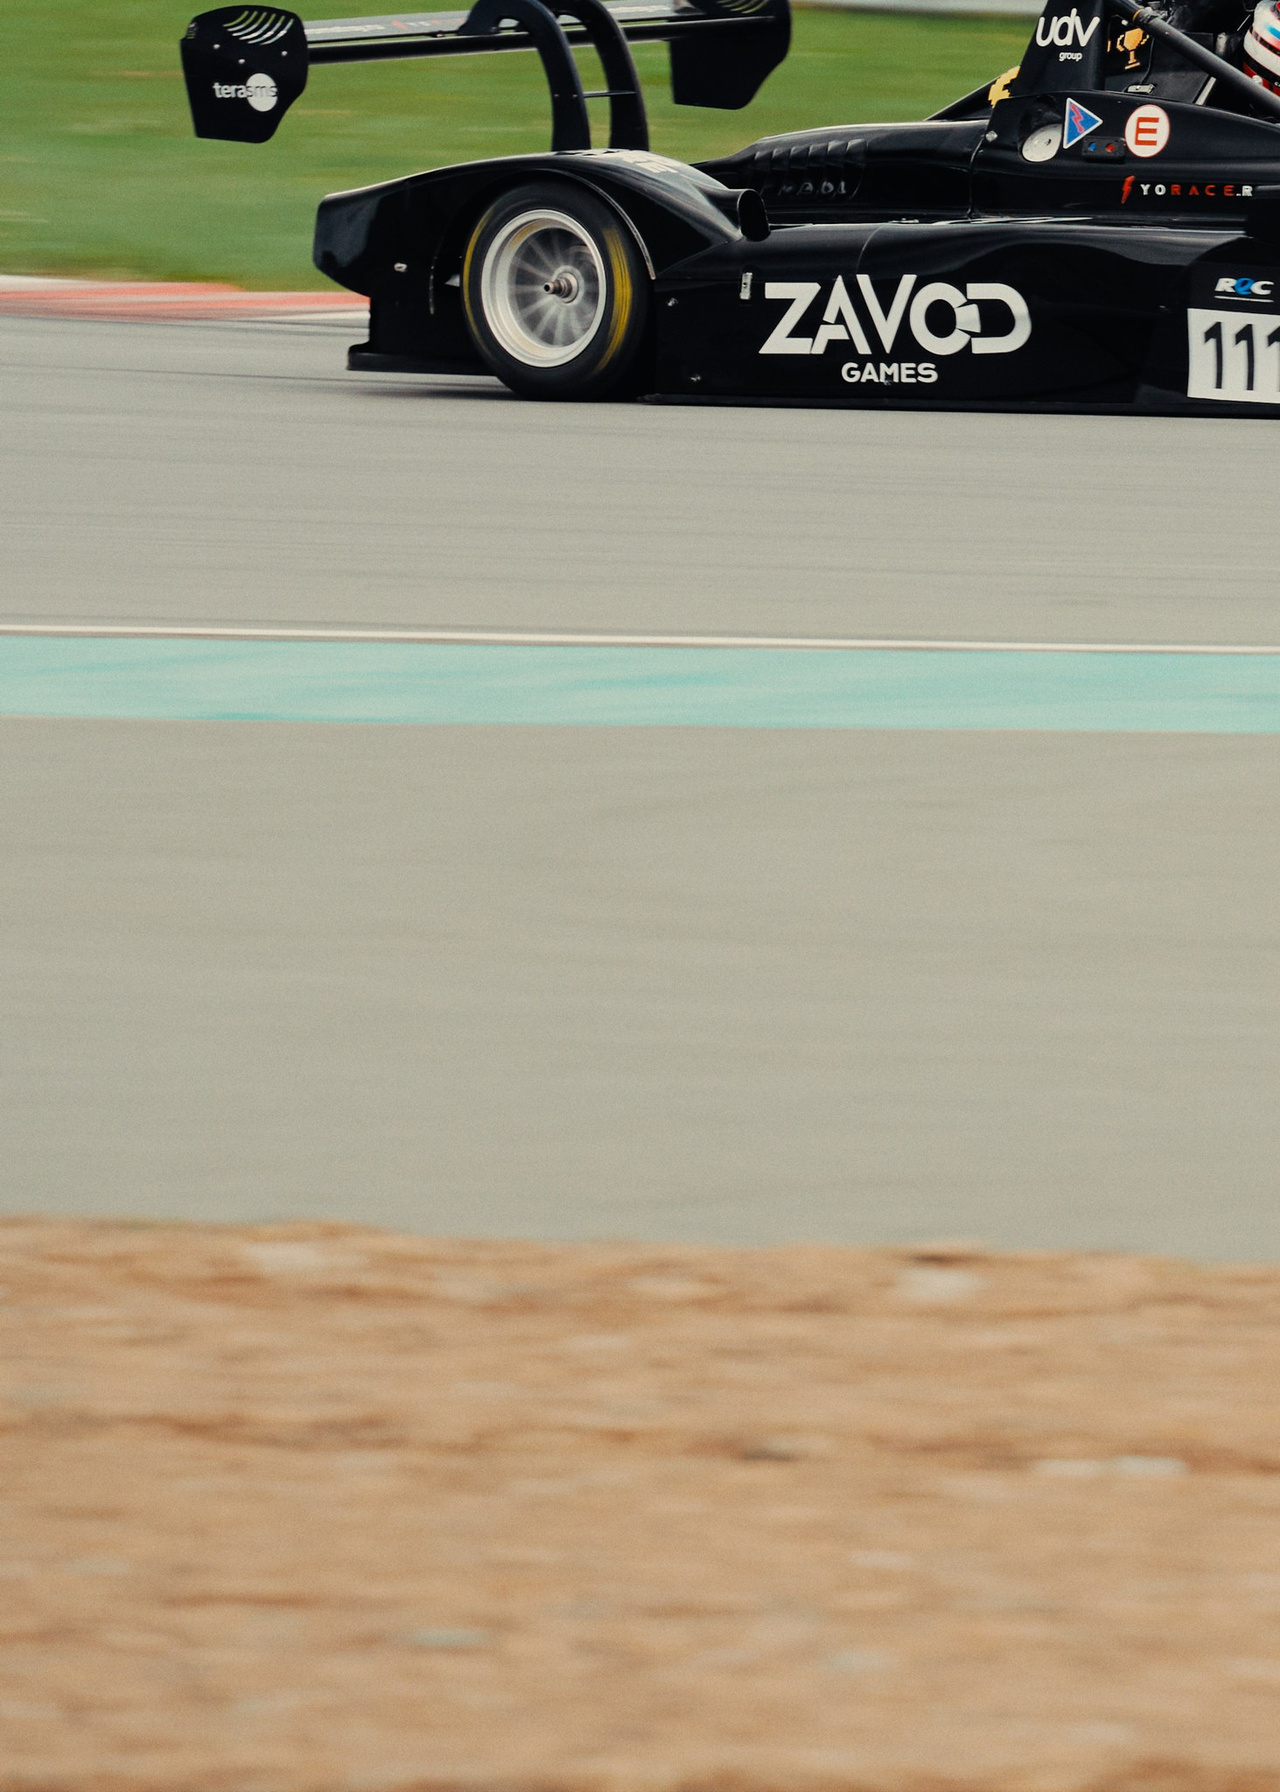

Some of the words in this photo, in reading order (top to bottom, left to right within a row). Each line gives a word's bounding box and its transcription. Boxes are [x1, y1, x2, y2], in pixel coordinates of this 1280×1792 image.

[1035, 8, 1100, 47] udv
[1058, 52, 1083, 62] group
[212, 82, 279, 99] terasms
[1135, 117, 1159, 146] E
[759, 274, 1032, 356] ZAVOD
[841, 362, 939, 384] GAMES
